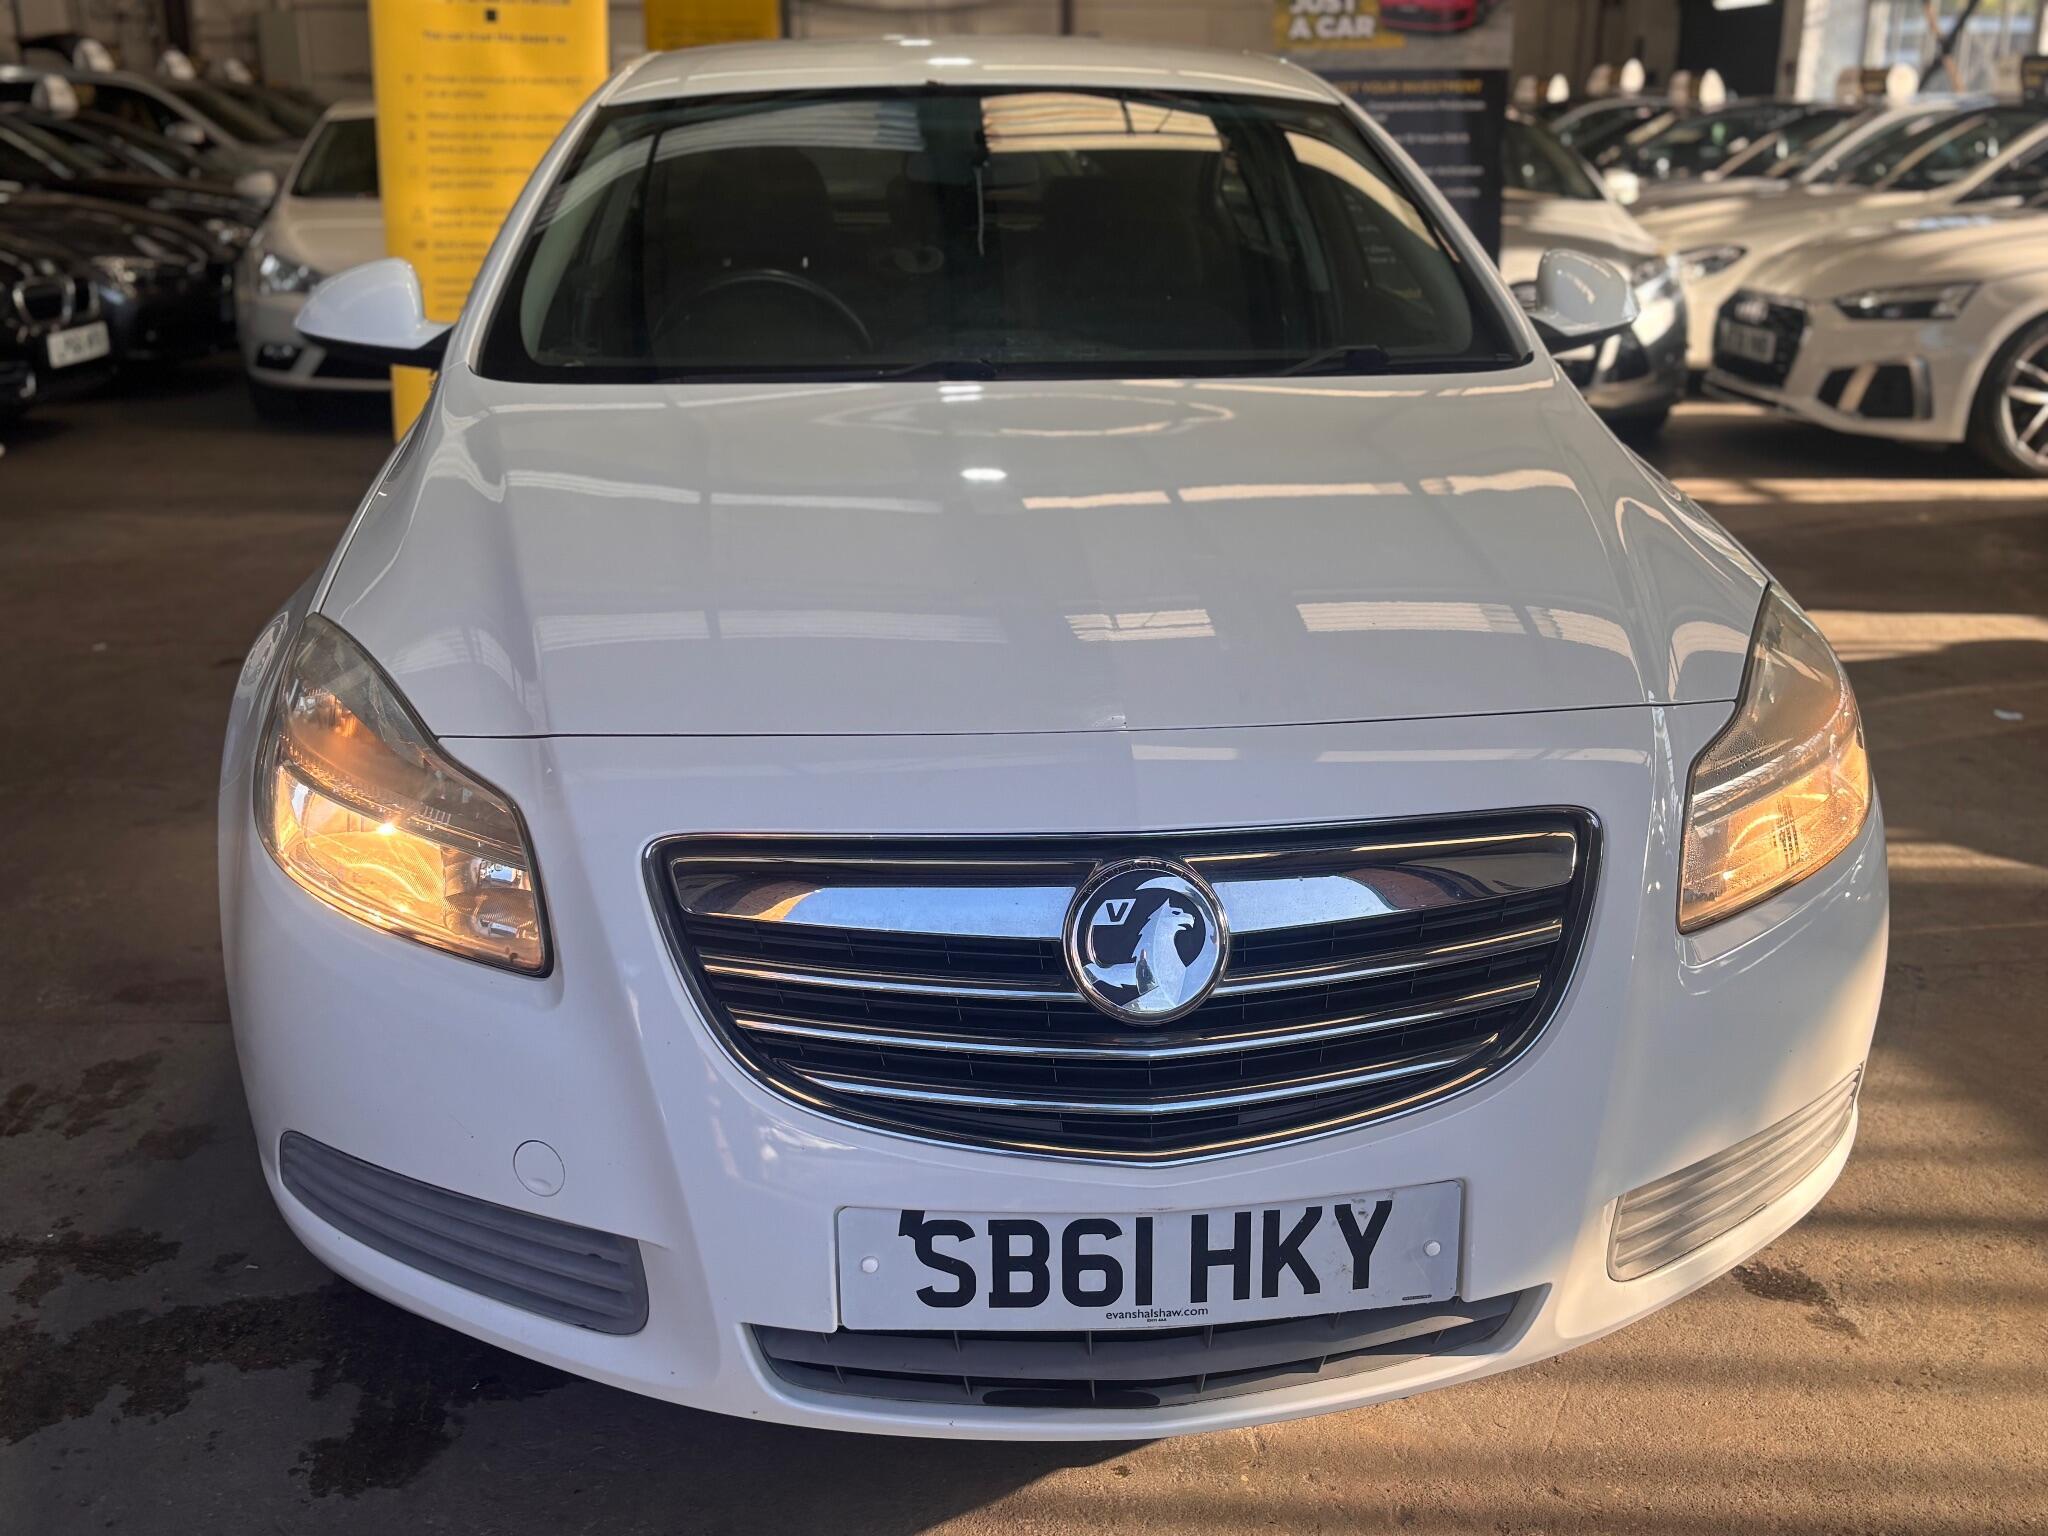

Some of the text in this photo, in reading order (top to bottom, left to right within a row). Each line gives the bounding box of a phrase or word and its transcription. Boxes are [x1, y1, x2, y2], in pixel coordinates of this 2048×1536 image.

[1288, 15, 1375, 39] A CAR
[914, 1199, 1393, 1308] SB61 HKY
[1105, 1307, 1209, 1320] evanshalshaw.com
